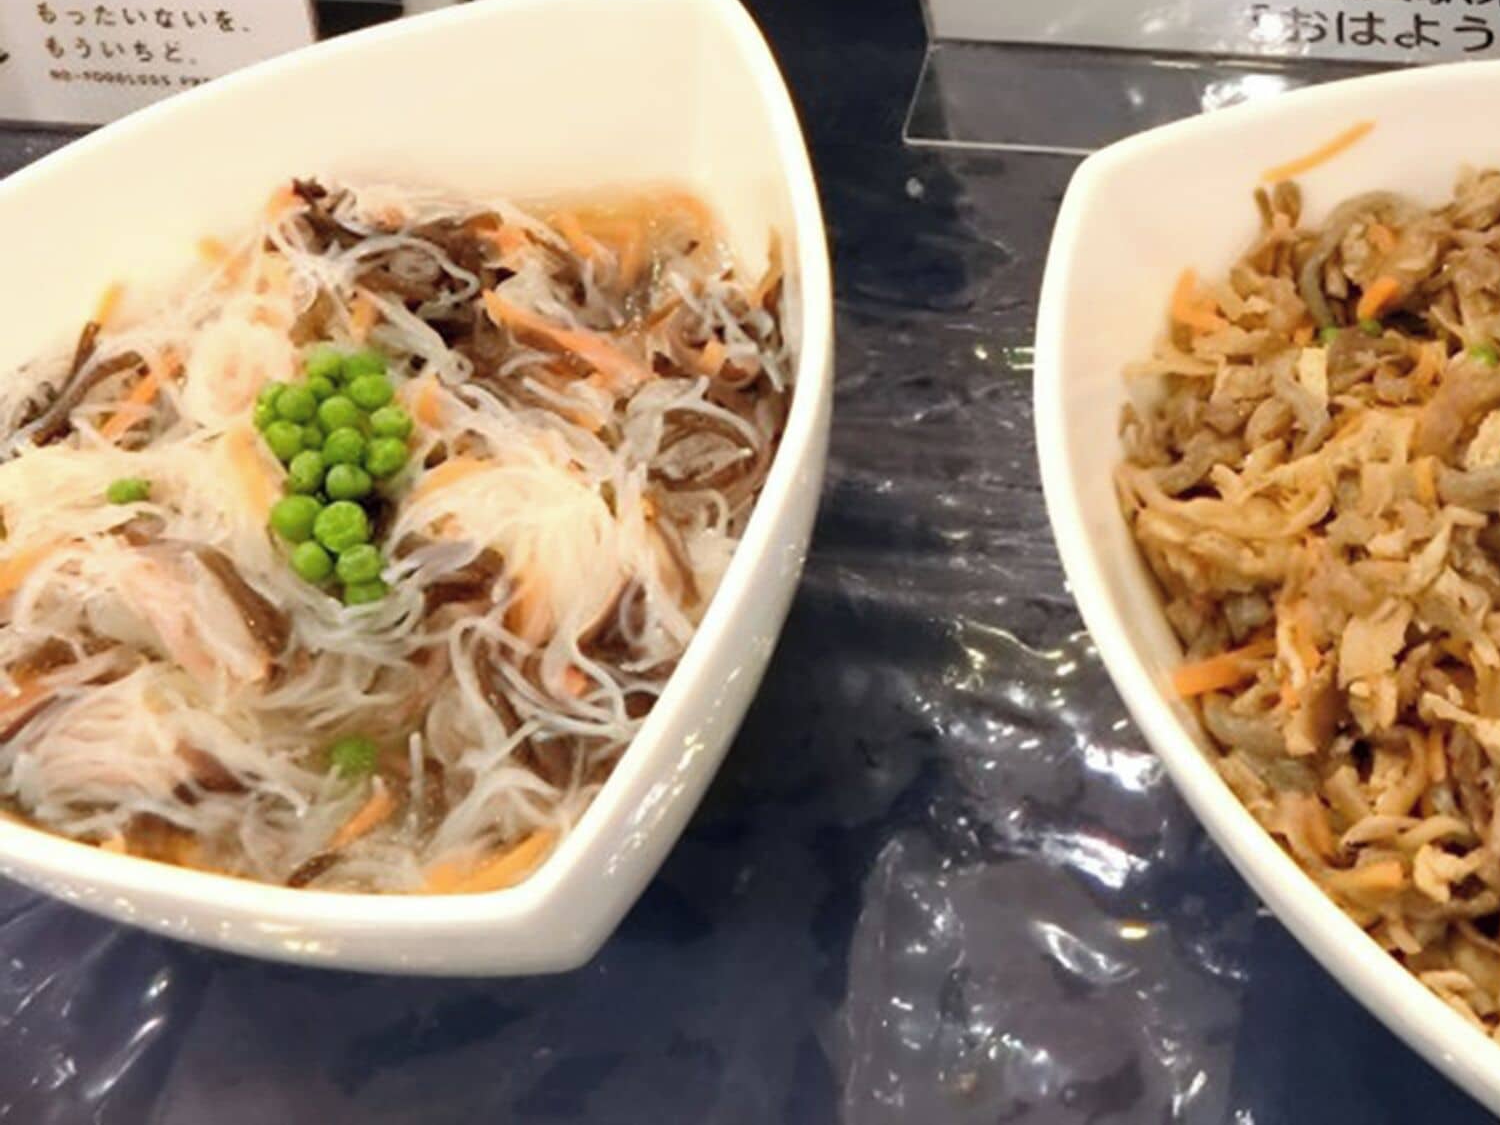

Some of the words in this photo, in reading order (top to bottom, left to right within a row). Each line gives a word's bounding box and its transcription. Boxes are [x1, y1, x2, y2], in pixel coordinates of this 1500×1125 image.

[37, 2, 250, 33] もったいないを、
